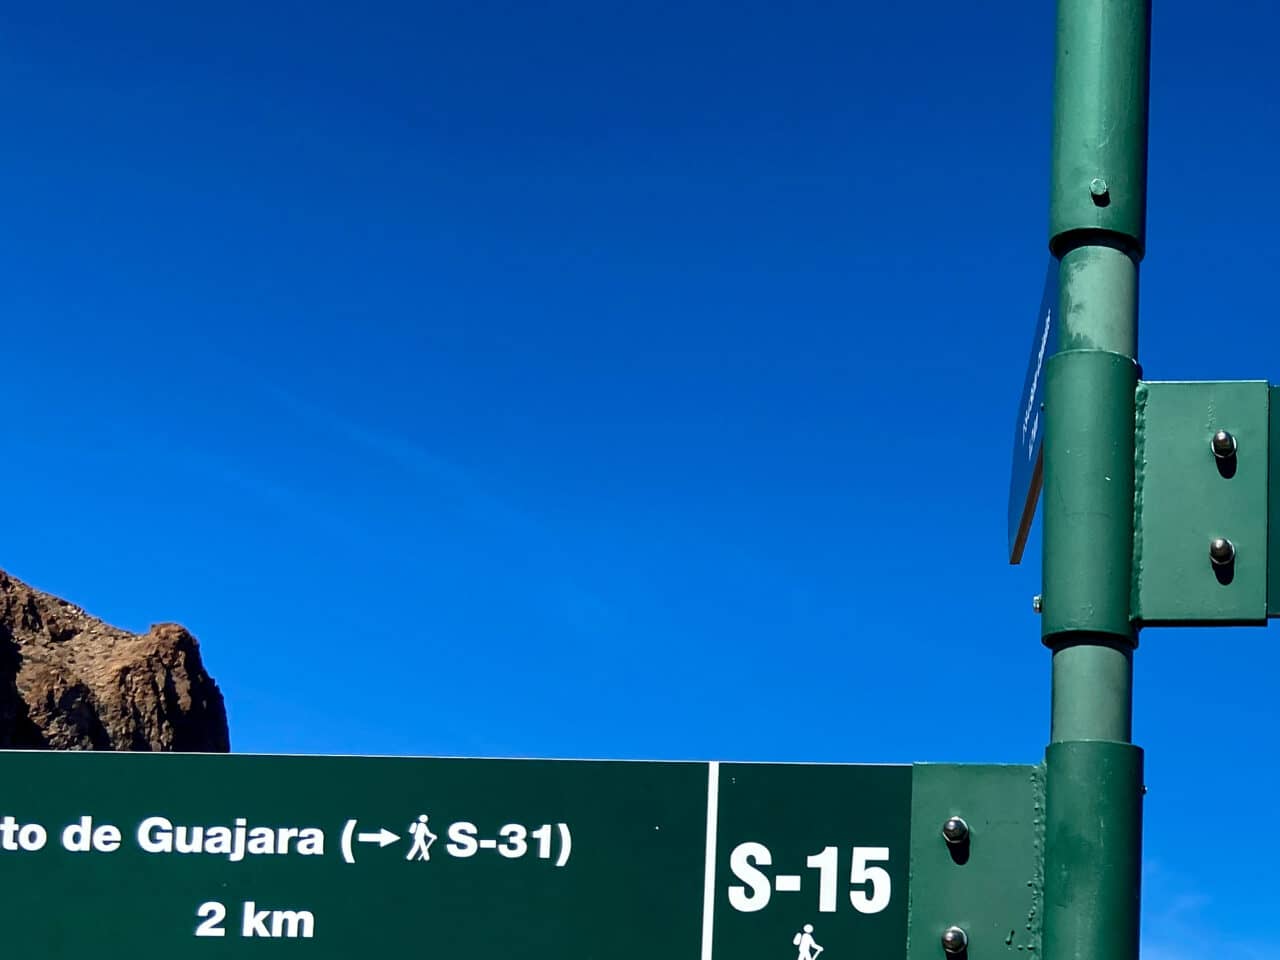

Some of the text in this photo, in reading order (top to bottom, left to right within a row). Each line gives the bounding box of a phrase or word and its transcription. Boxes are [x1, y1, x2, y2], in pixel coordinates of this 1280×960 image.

[61, 815, 122, 852] de
[137, 816, 325, 862] Guajara
[727, 841, 892, 914] S-15
[195, 901, 315, 938] 2 km
